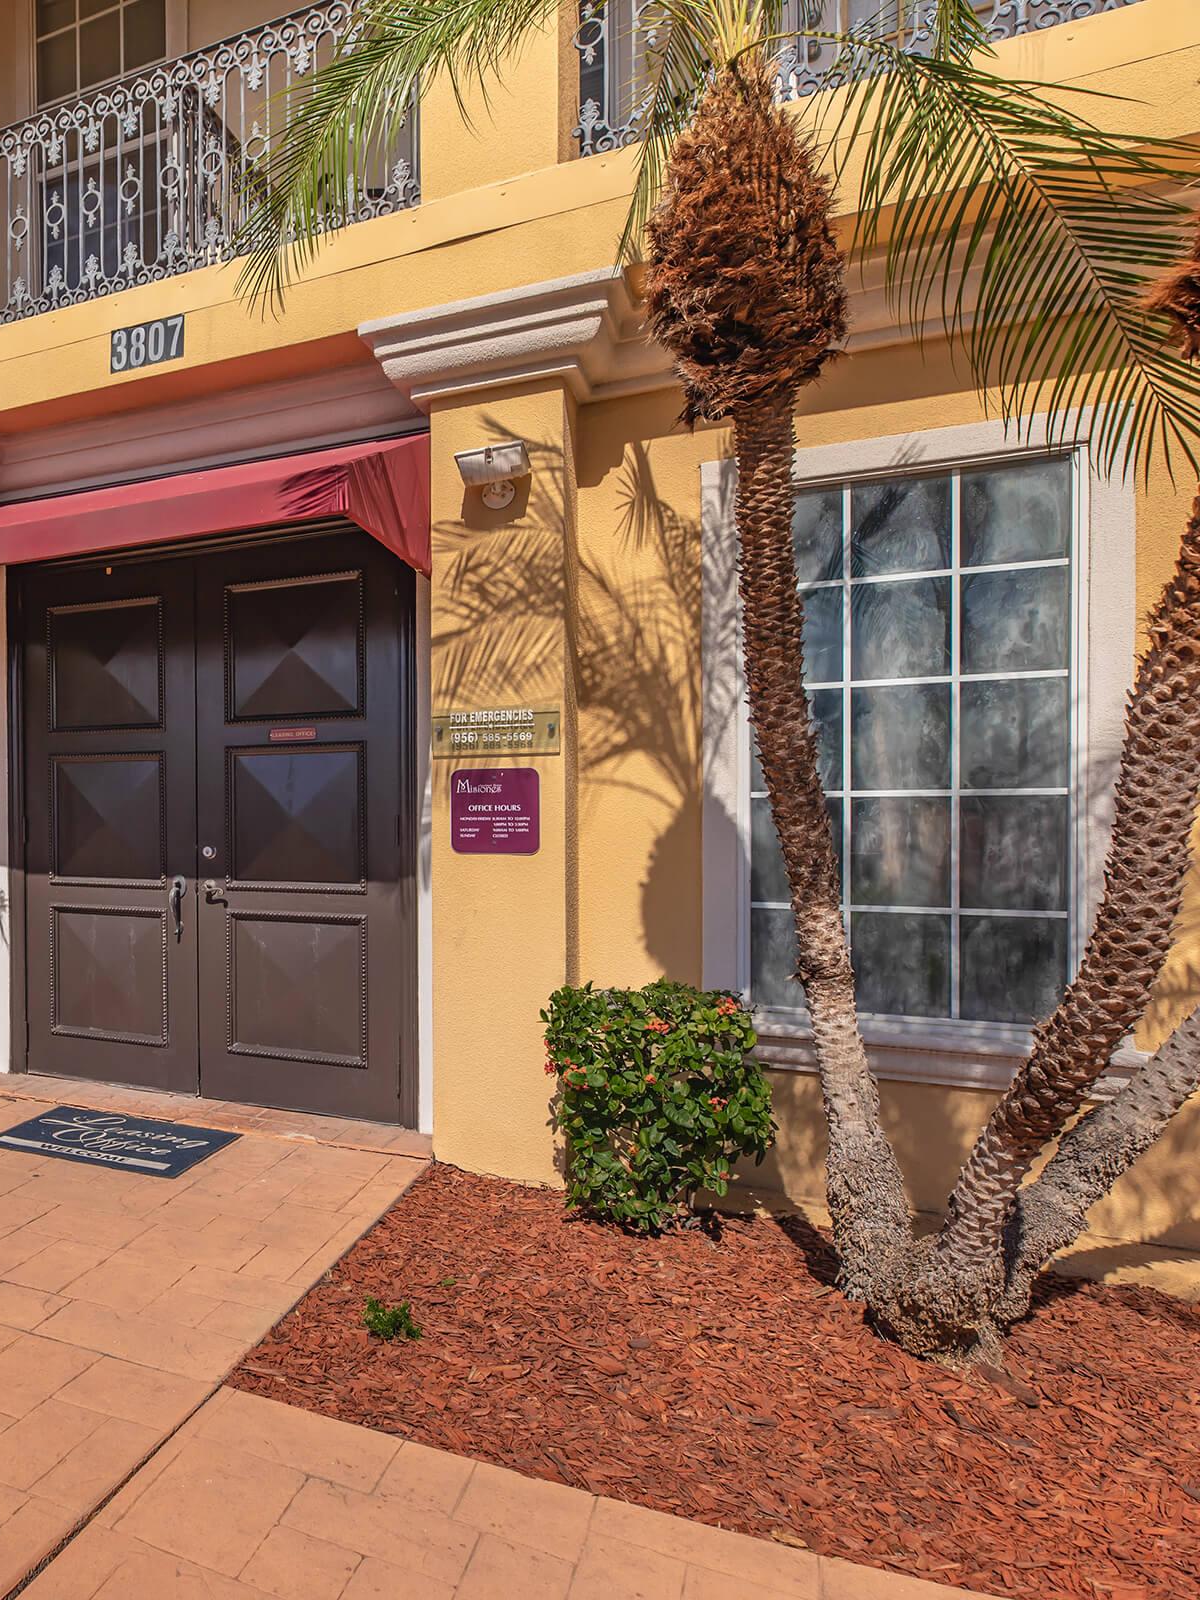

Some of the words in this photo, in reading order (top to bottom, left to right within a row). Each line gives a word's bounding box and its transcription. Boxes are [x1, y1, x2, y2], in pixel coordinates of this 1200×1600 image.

[111, 316, 183, 370] 3807
[450, 712, 467, 723] FOR
[470, 709, 533, 722] EMERGENCIES
[451, 732, 478, 743] (956)
[482, 732, 532, 742] 585-5569
[468, 804, 493, 812] OFFICE
[494, 804, 521, 812] HOURS
[39, 1116, 210, 1149] Leasing
[52, 1128, 172, 1156] Office
[40, 1143, 127, 1162] WELCOME
